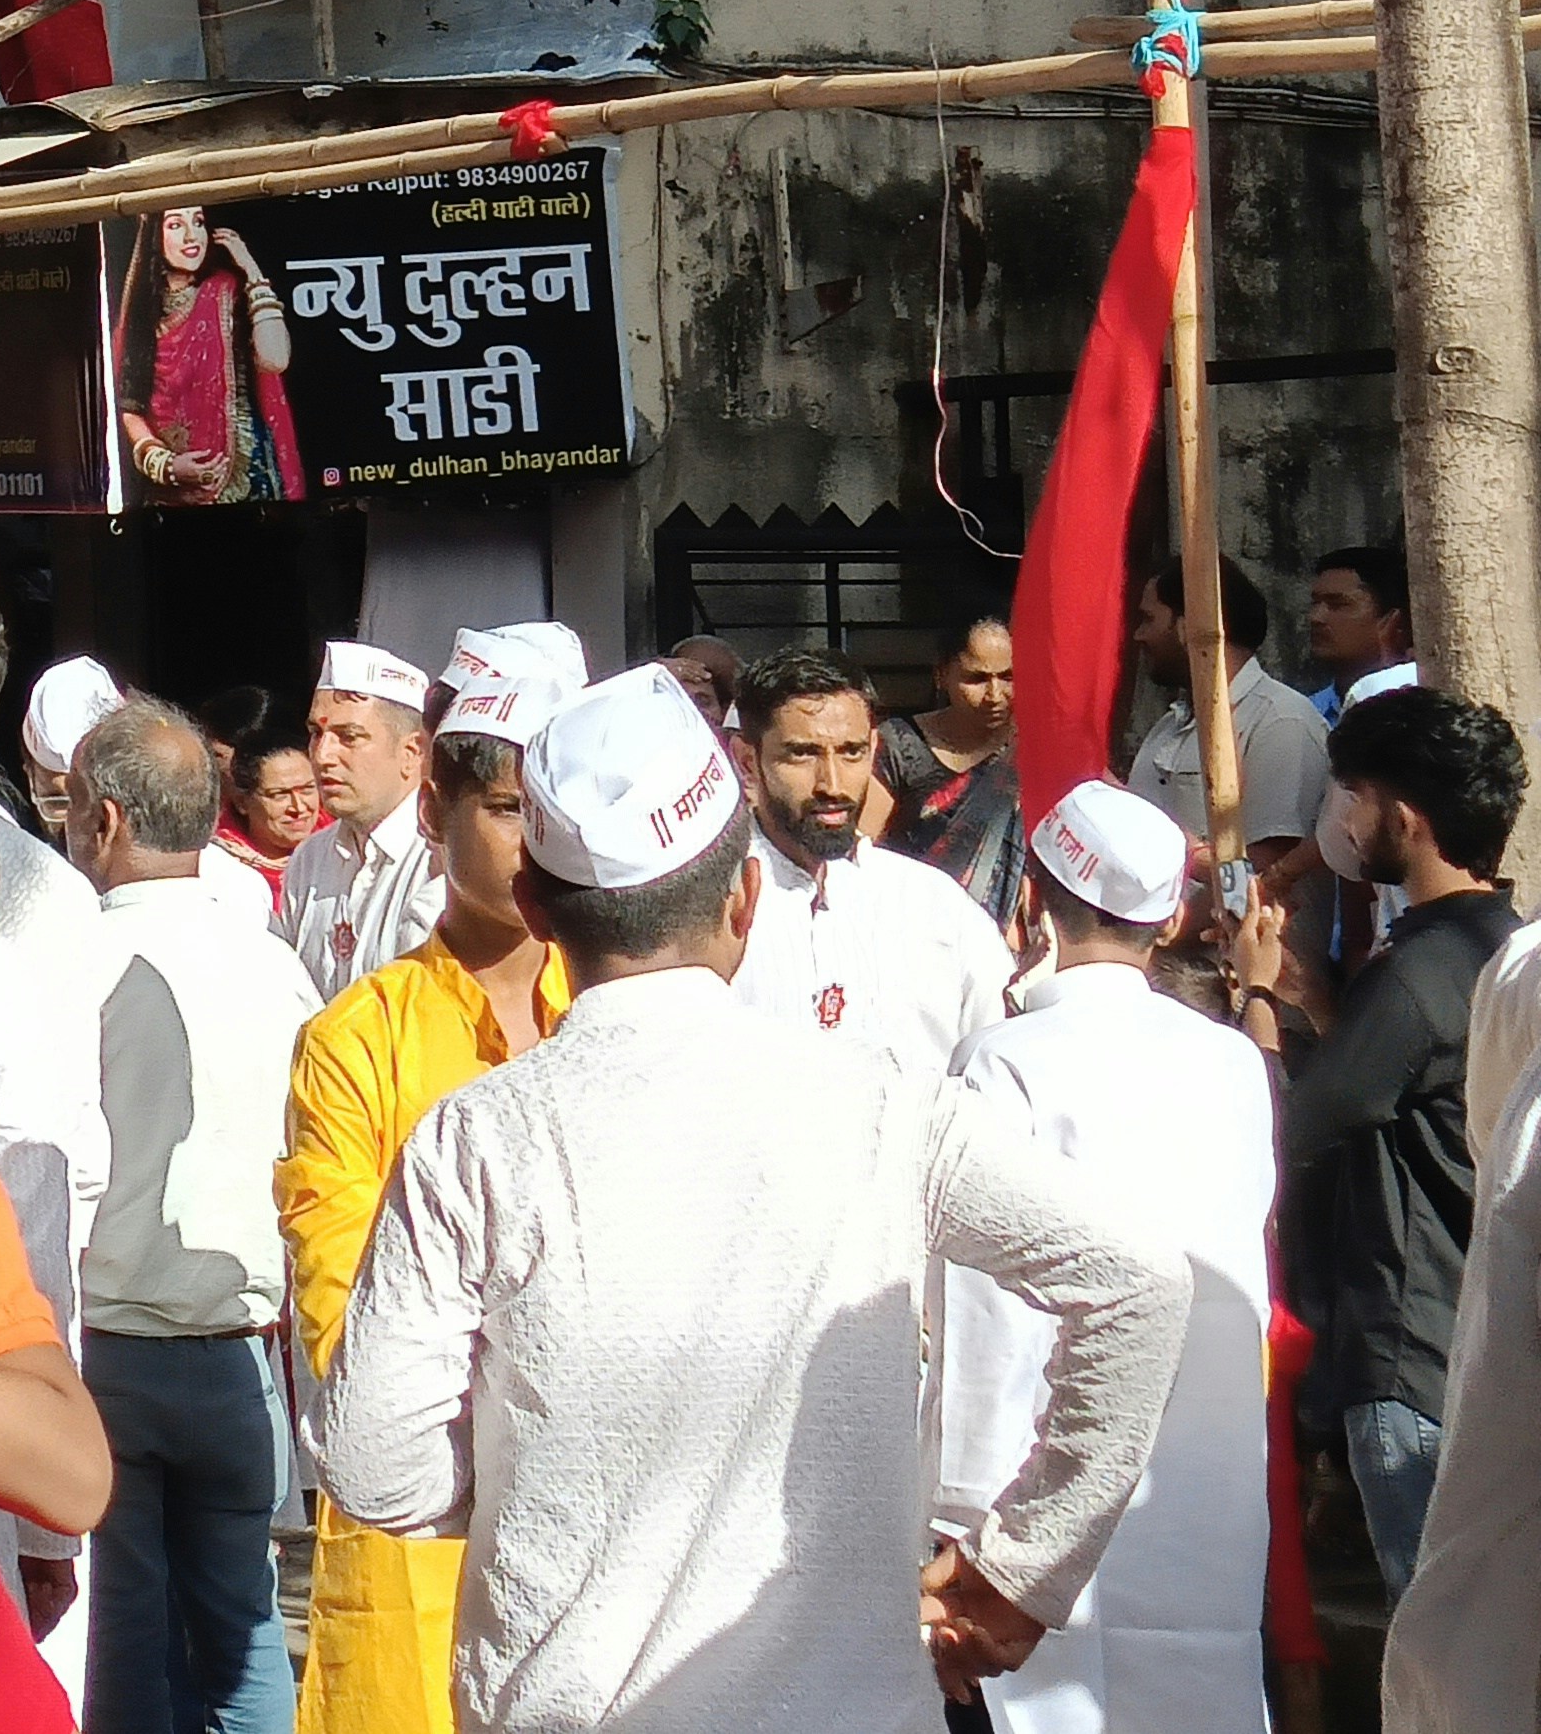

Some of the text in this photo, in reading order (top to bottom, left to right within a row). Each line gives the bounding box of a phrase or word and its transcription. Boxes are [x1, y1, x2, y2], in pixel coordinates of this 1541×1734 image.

[457, 160, 590, 189] 9834900267
[286, 243, 592, 352] न्यु दुल्हन
[381, 345, 541, 442] साडी
[349, 444, 622, 485] new_dulhan_bhayandar
